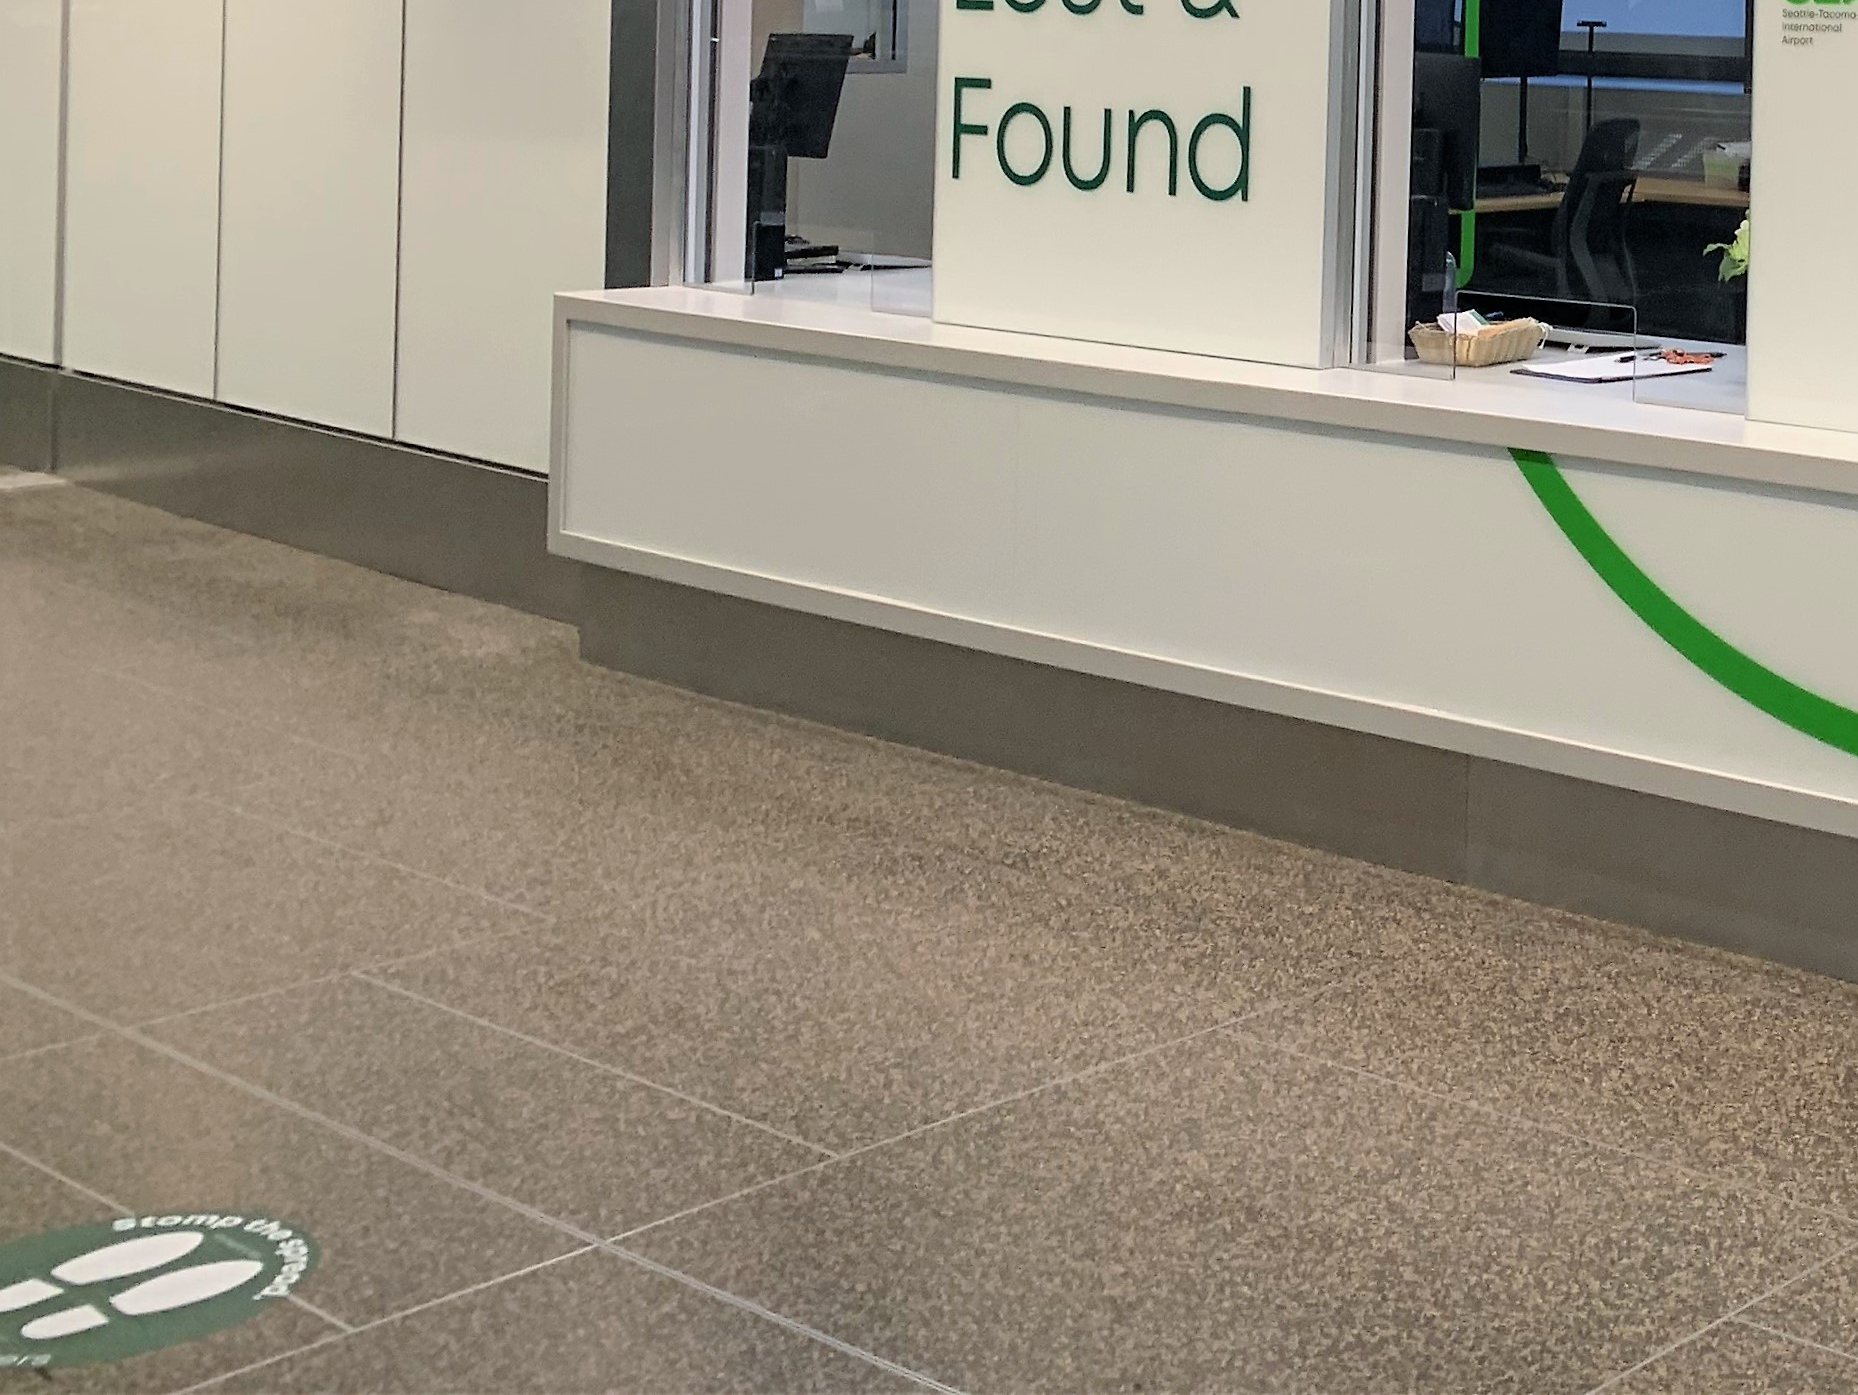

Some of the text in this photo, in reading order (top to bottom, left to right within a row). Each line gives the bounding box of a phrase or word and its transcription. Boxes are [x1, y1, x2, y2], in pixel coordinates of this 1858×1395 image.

[1782, 9, 1856, 19] Seattle-Tacoma
[1782, 23, 1842, 32] International
[1782, 35, 1813, 45] Airport
[952, 77, 1251, 202] Found
